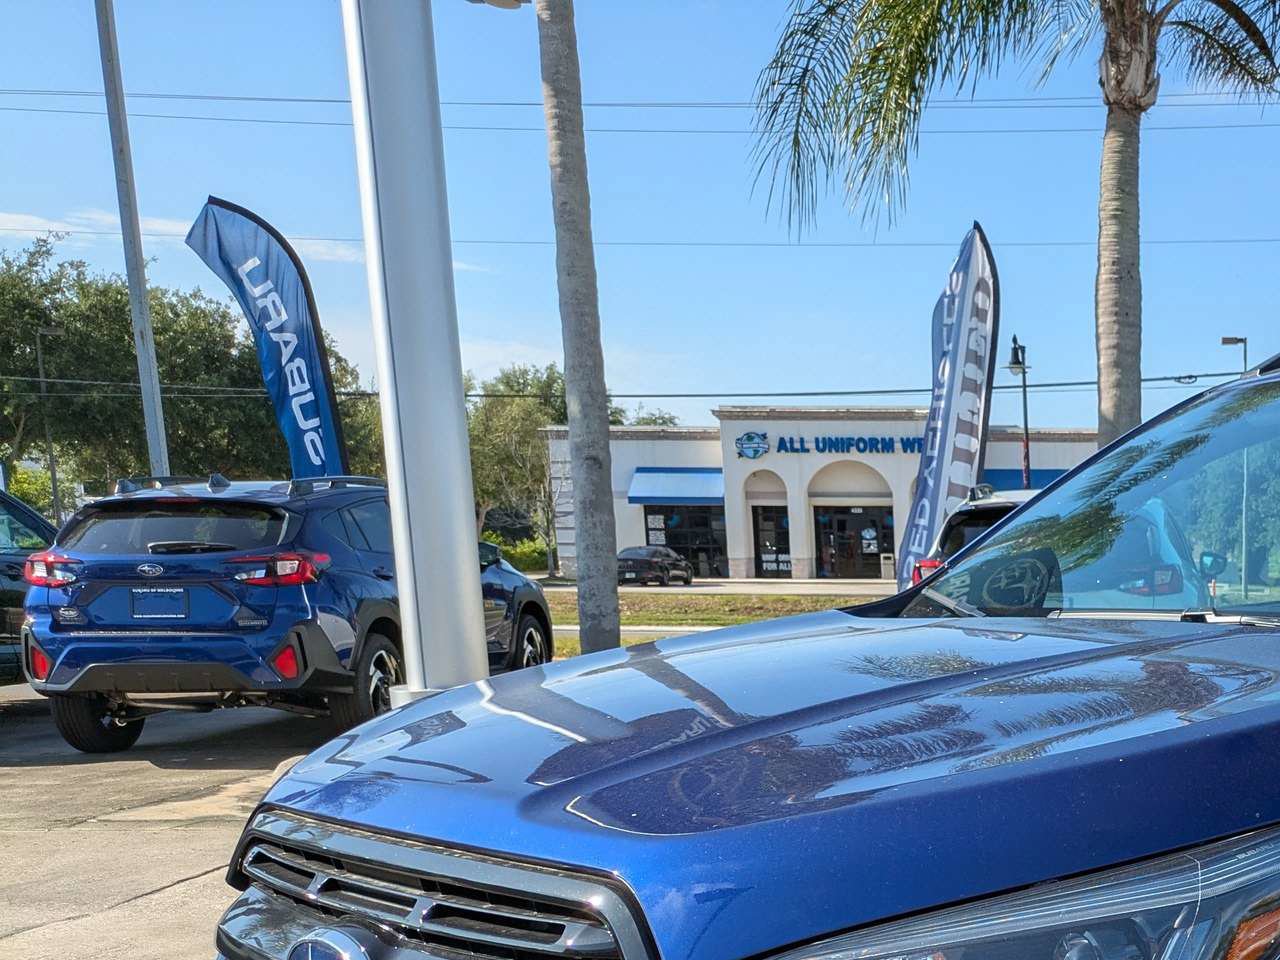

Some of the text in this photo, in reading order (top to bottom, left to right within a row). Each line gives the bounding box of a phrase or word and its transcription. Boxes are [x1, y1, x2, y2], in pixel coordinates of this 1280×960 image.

[776, 436, 811, 453] ALL
[815, 436, 894, 453] UNIFORM
[1236, 842, 1274, 859] SUBARU
